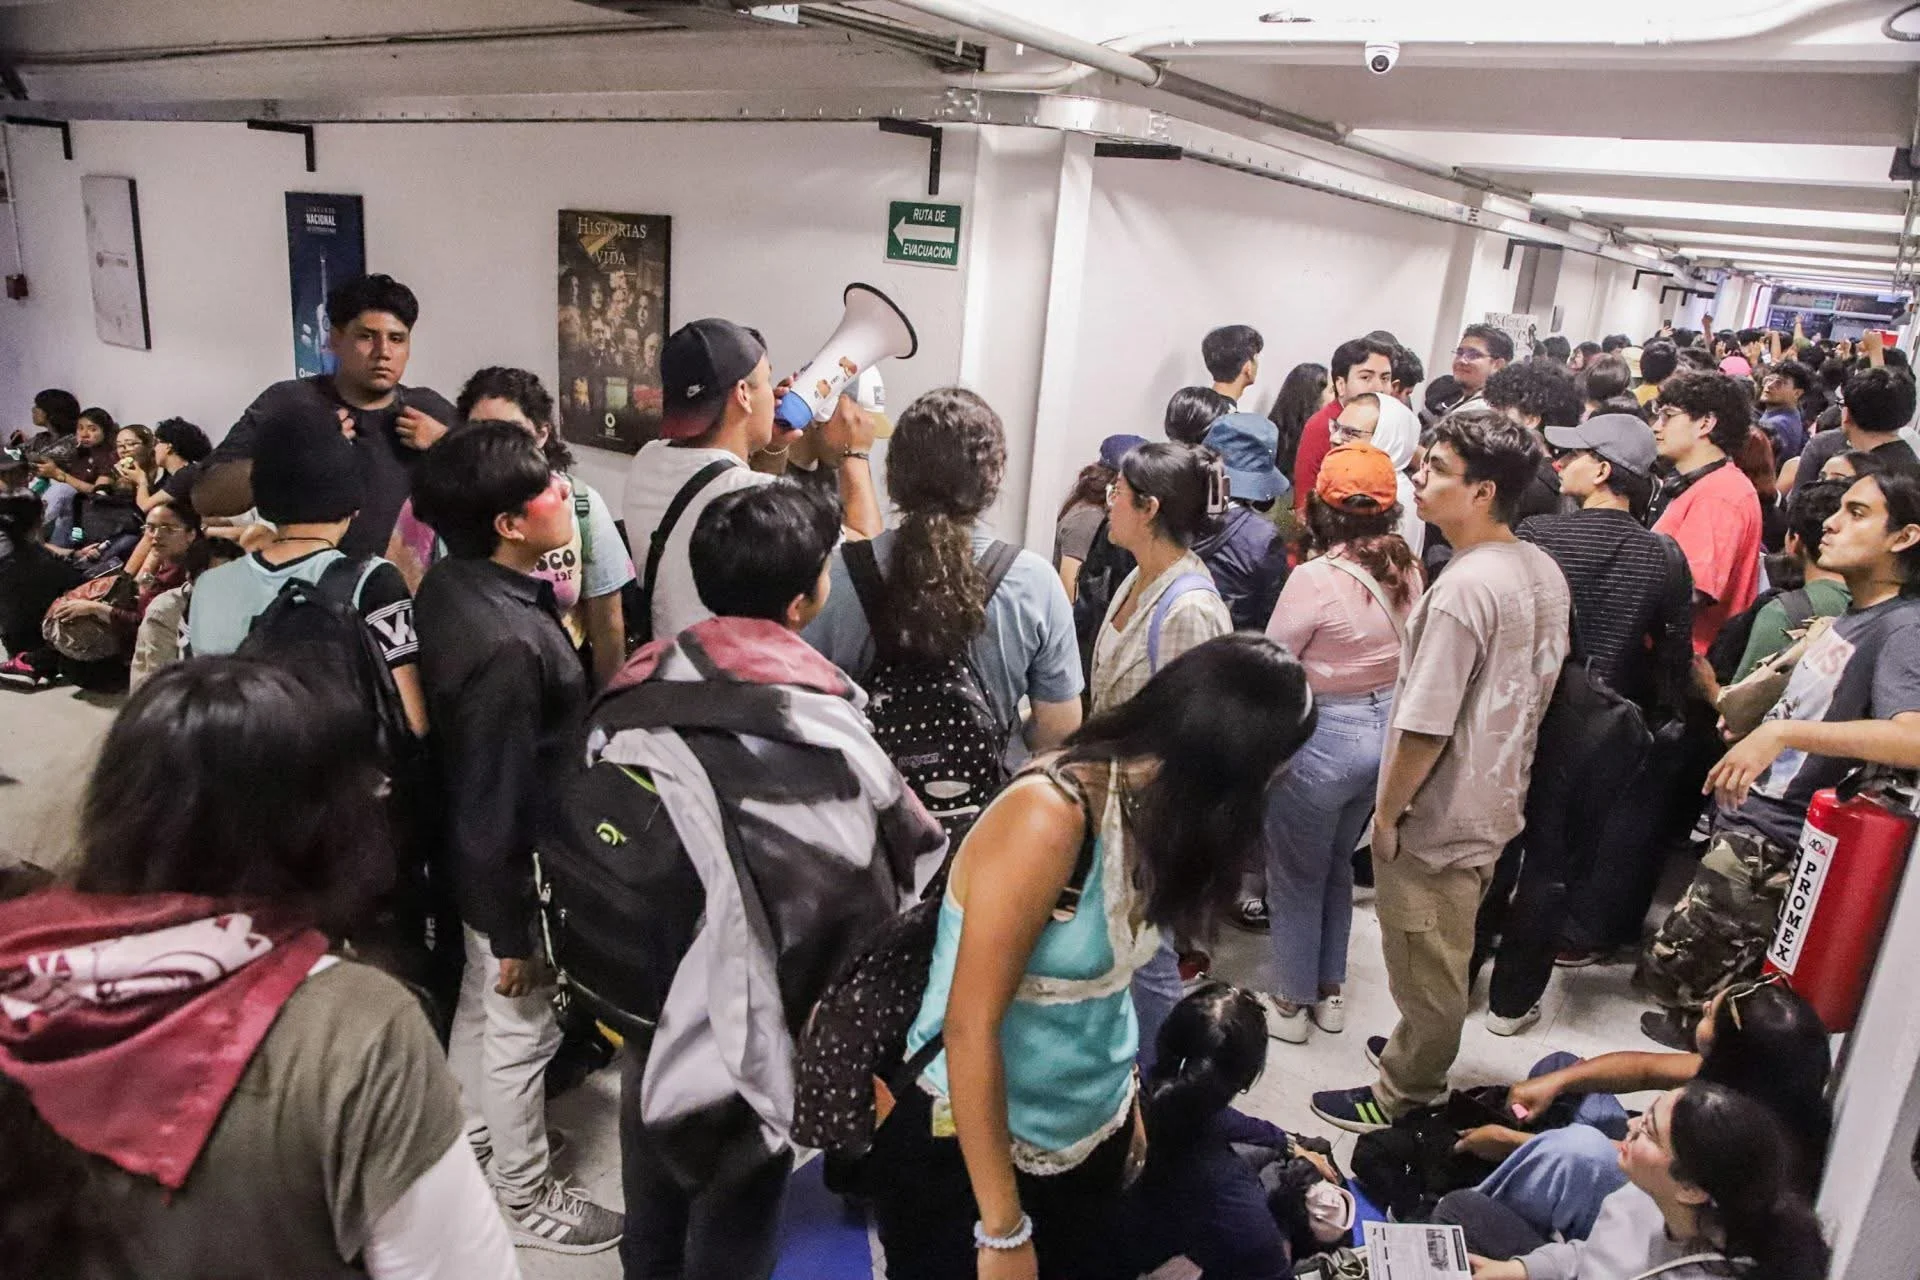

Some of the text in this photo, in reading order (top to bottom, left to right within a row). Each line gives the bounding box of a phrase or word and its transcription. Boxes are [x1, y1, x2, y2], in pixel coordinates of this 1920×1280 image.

[306, 214, 336, 226] NACIONAL
[913, 208, 946, 222] RUTA DE
[577, 217, 647, 238] HISTORIAS
[596, 251, 626, 265] VIDA
[903, 243, 952, 259] EVACUACION
[535, 549, 576, 571] SCO
[1776, 861, 1816, 962] PROMEX
